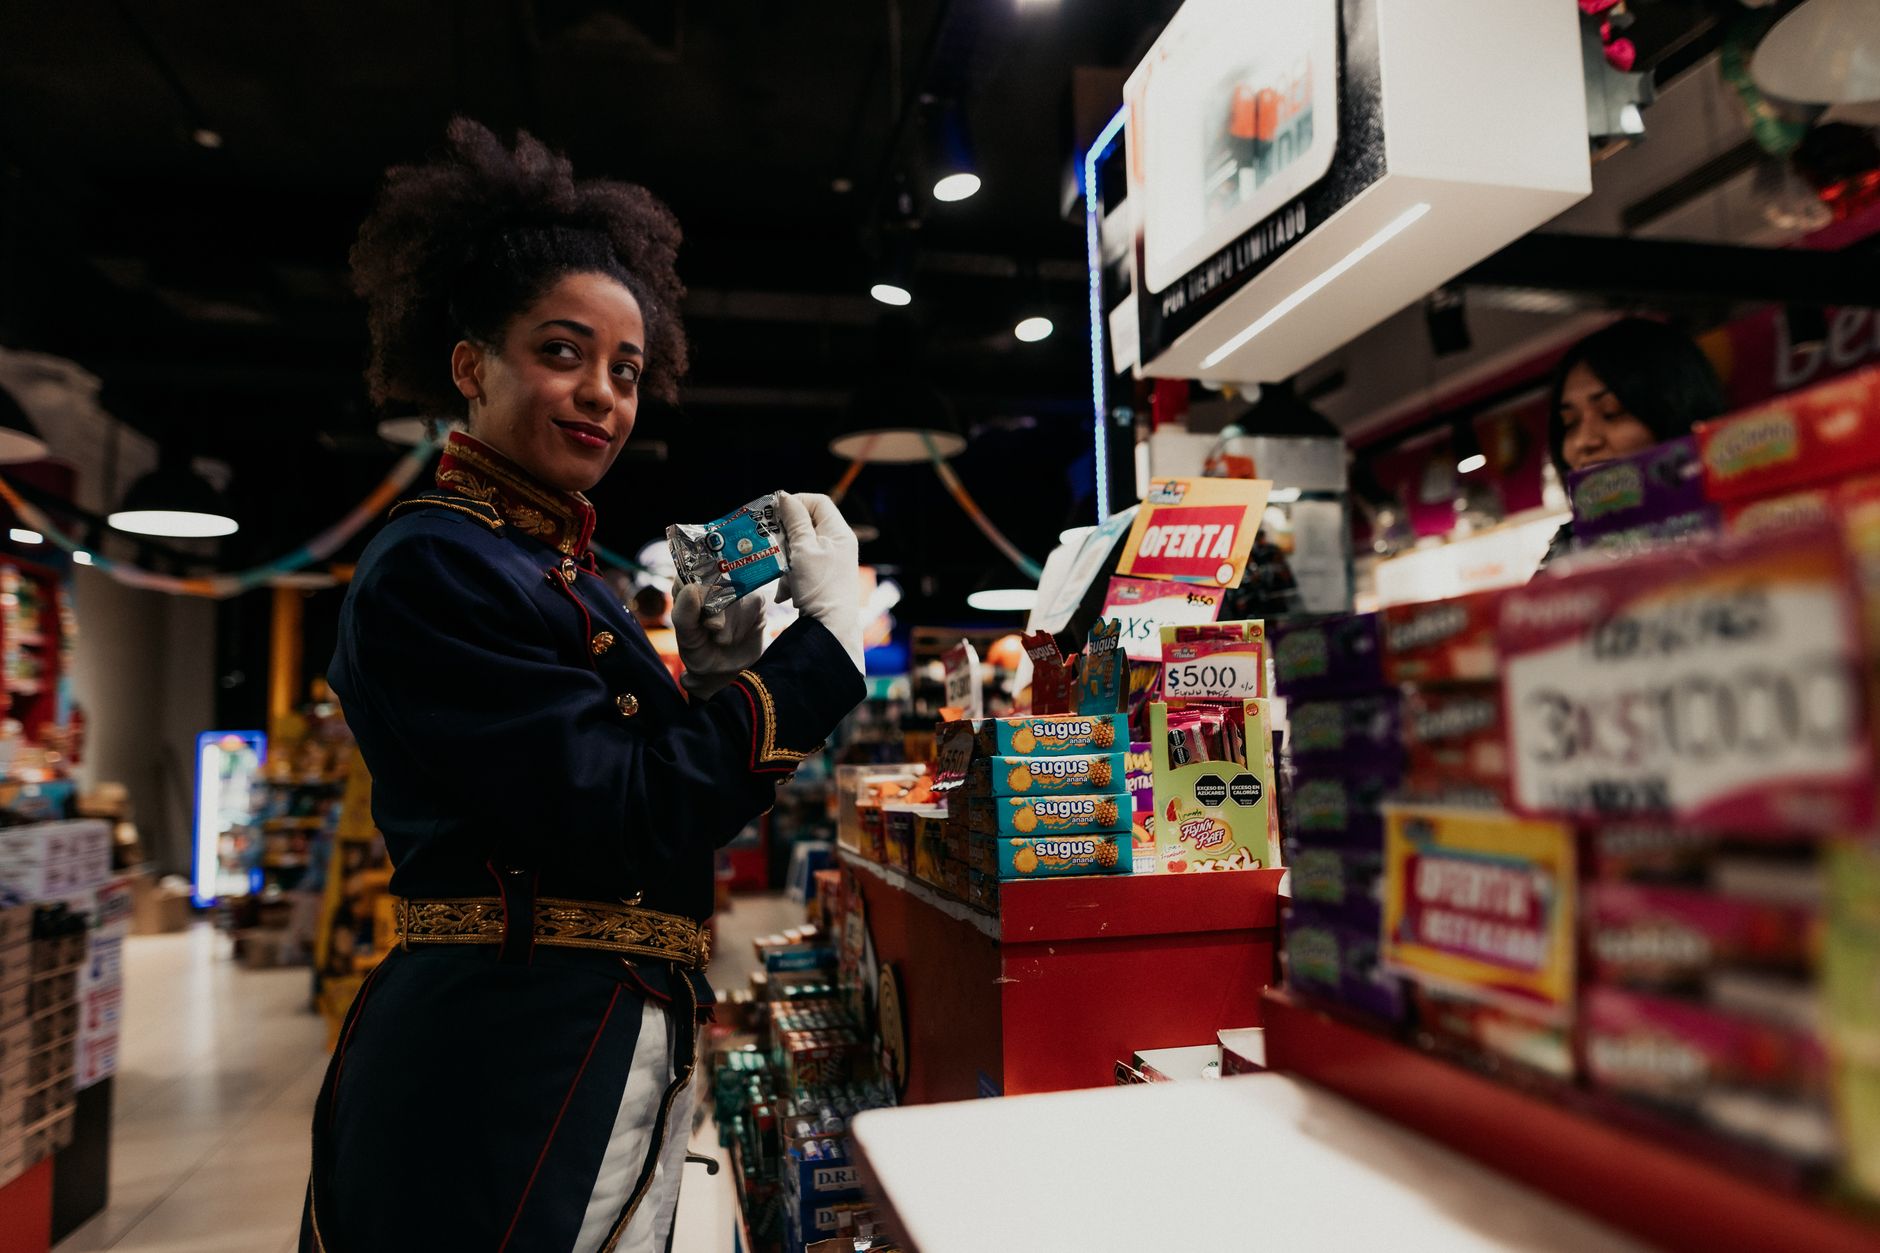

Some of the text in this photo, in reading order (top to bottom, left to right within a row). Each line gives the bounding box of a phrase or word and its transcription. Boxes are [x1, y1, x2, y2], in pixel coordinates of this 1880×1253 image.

[1138, 524, 1235, 558] OFERTA
[1028, 643, 1056, 661] sugus
[1088, 636, 1117, 656] sugus
[1168, 665, 1237, 689] $500
[1033, 721, 1092, 739] sugus
[1030, 760, 1089, 777] sugus
[1034, 800, 1095, 818] sugus
[1034, 840, 1096, 858] sugus
